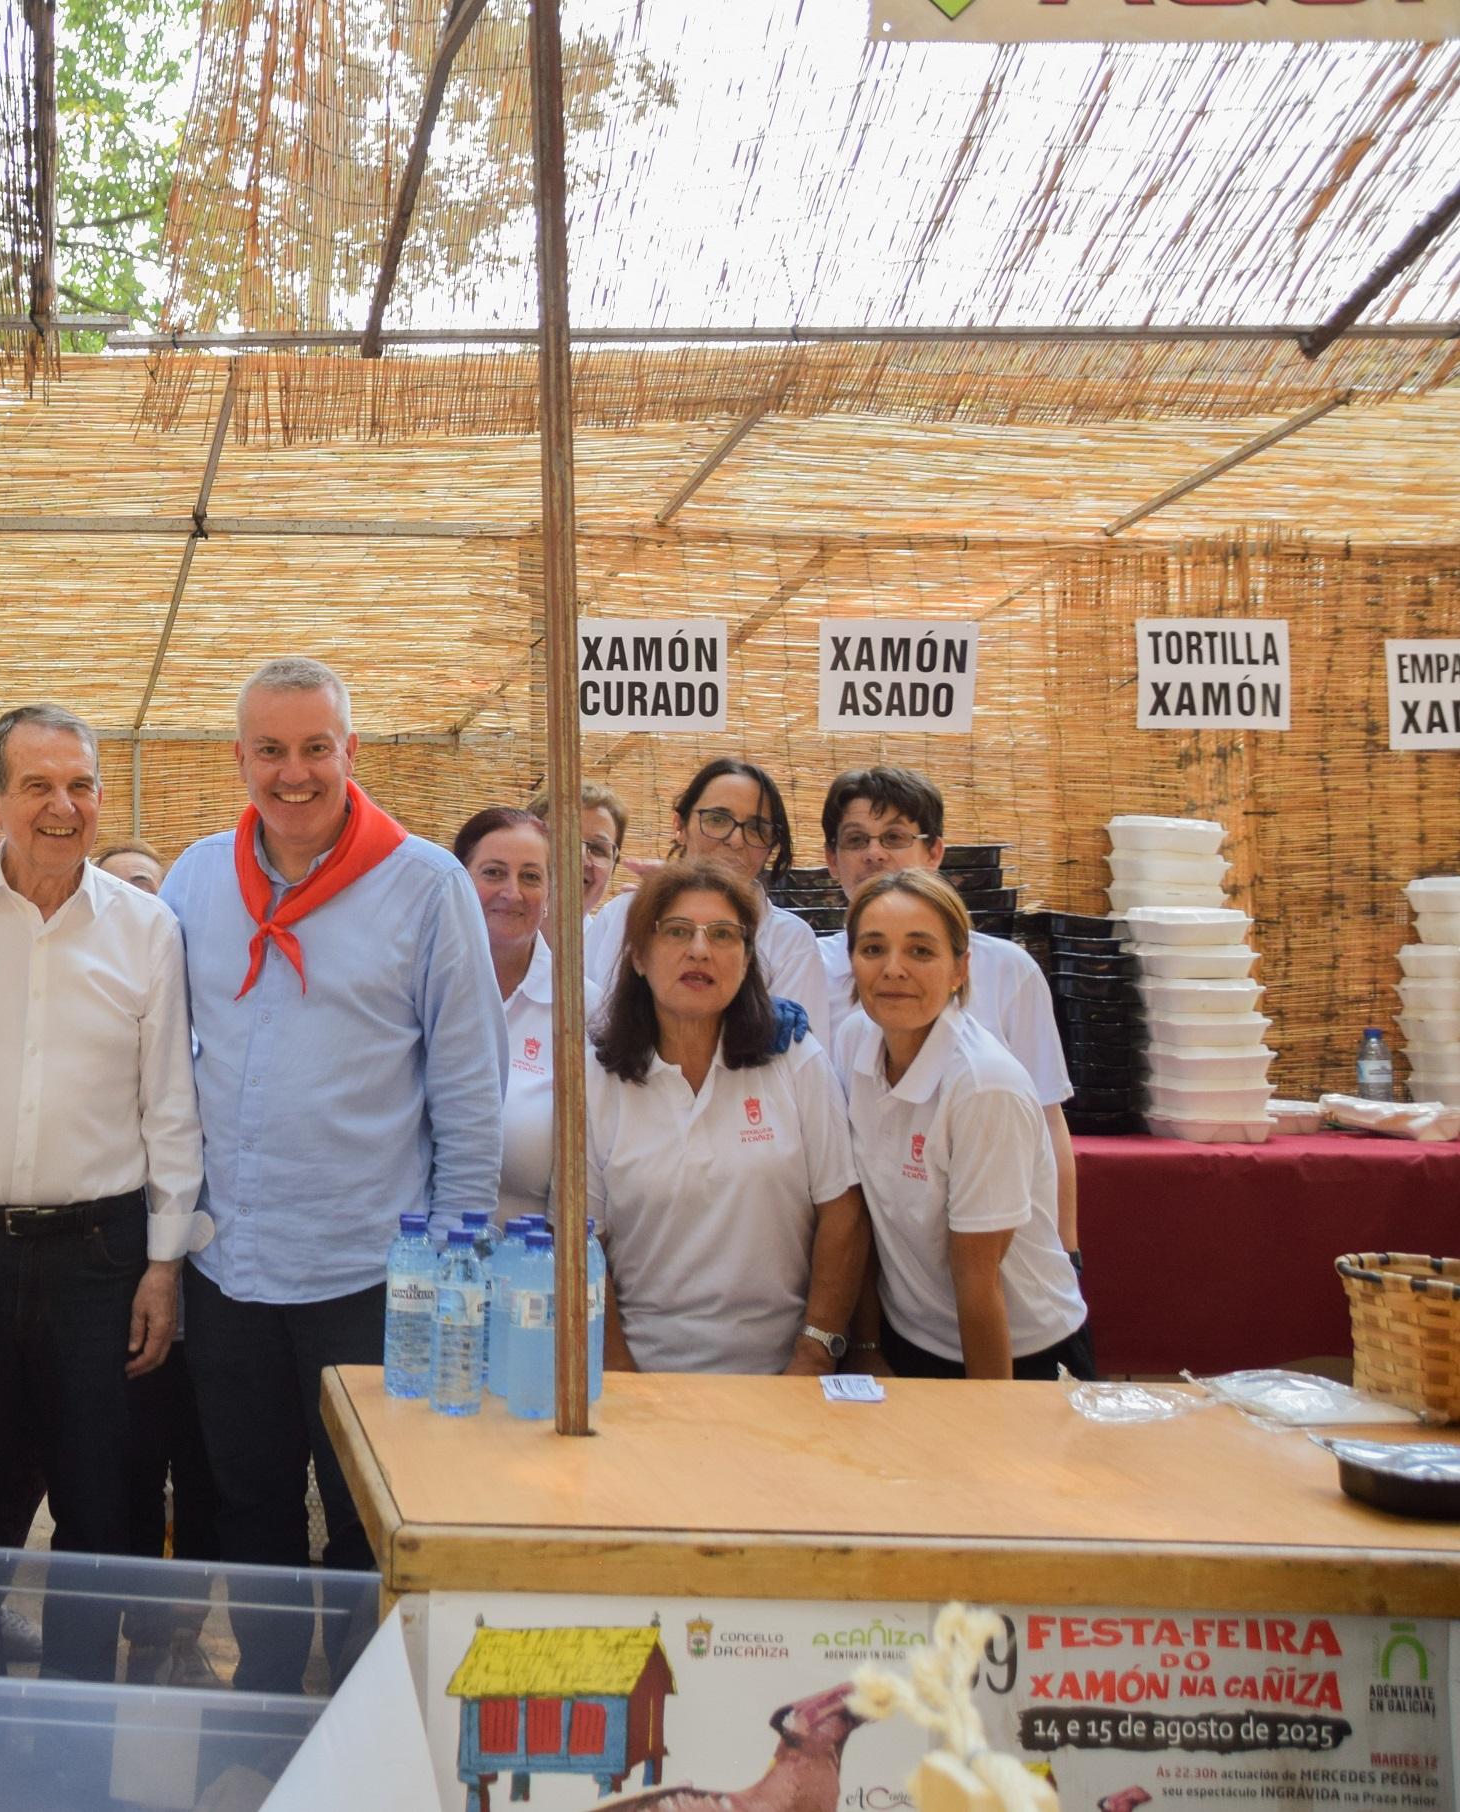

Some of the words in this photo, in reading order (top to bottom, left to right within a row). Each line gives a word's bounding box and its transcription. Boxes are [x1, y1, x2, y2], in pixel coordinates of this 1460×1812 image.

[581, 629, 717, 673] XAMÓN
[830, 630, 968, 674] XAMÓN
[1147, 631, 1280, 666] TORTILLA
[580, 680, 719, 717] CURADO
[838, 681, 953, 717] ASADO
[1148, 674, 1281, 717] XAMÓN
[1027, 1615, 1342, 1656] FESTA-FEIRA
[972, 1614, 1017, 1694] 9
[1160, 1652, 1210, 1672] DO
[1029, 1664, 1169, 1704] XAMÓN
[1179, 1675, 1217, 1698] NA
[1223, 1667, 1343, 1711] CAÑIZA
[1369, 1699, 1384, 1712] EN
[1033, 1719, 1061, 1742] 14
[1067, 1722, 1080, 1737] e
[1086, 1720, 1112, 1745] 15
[1118, 1716, 1146, 1738] de
[1153, 1721, 1234, 1750] agosto
[1240, 1717, 1269, 1742] de
[1277, 1723, 1333, 1747] 2025
[1282, 1769, 1296, 1781] de
[1300, 1768, 1376, 1784] MERCEDES
[1371, 1752, 1421, 1767] MARTES
[1162, 1786, 1183, 1796] seu
